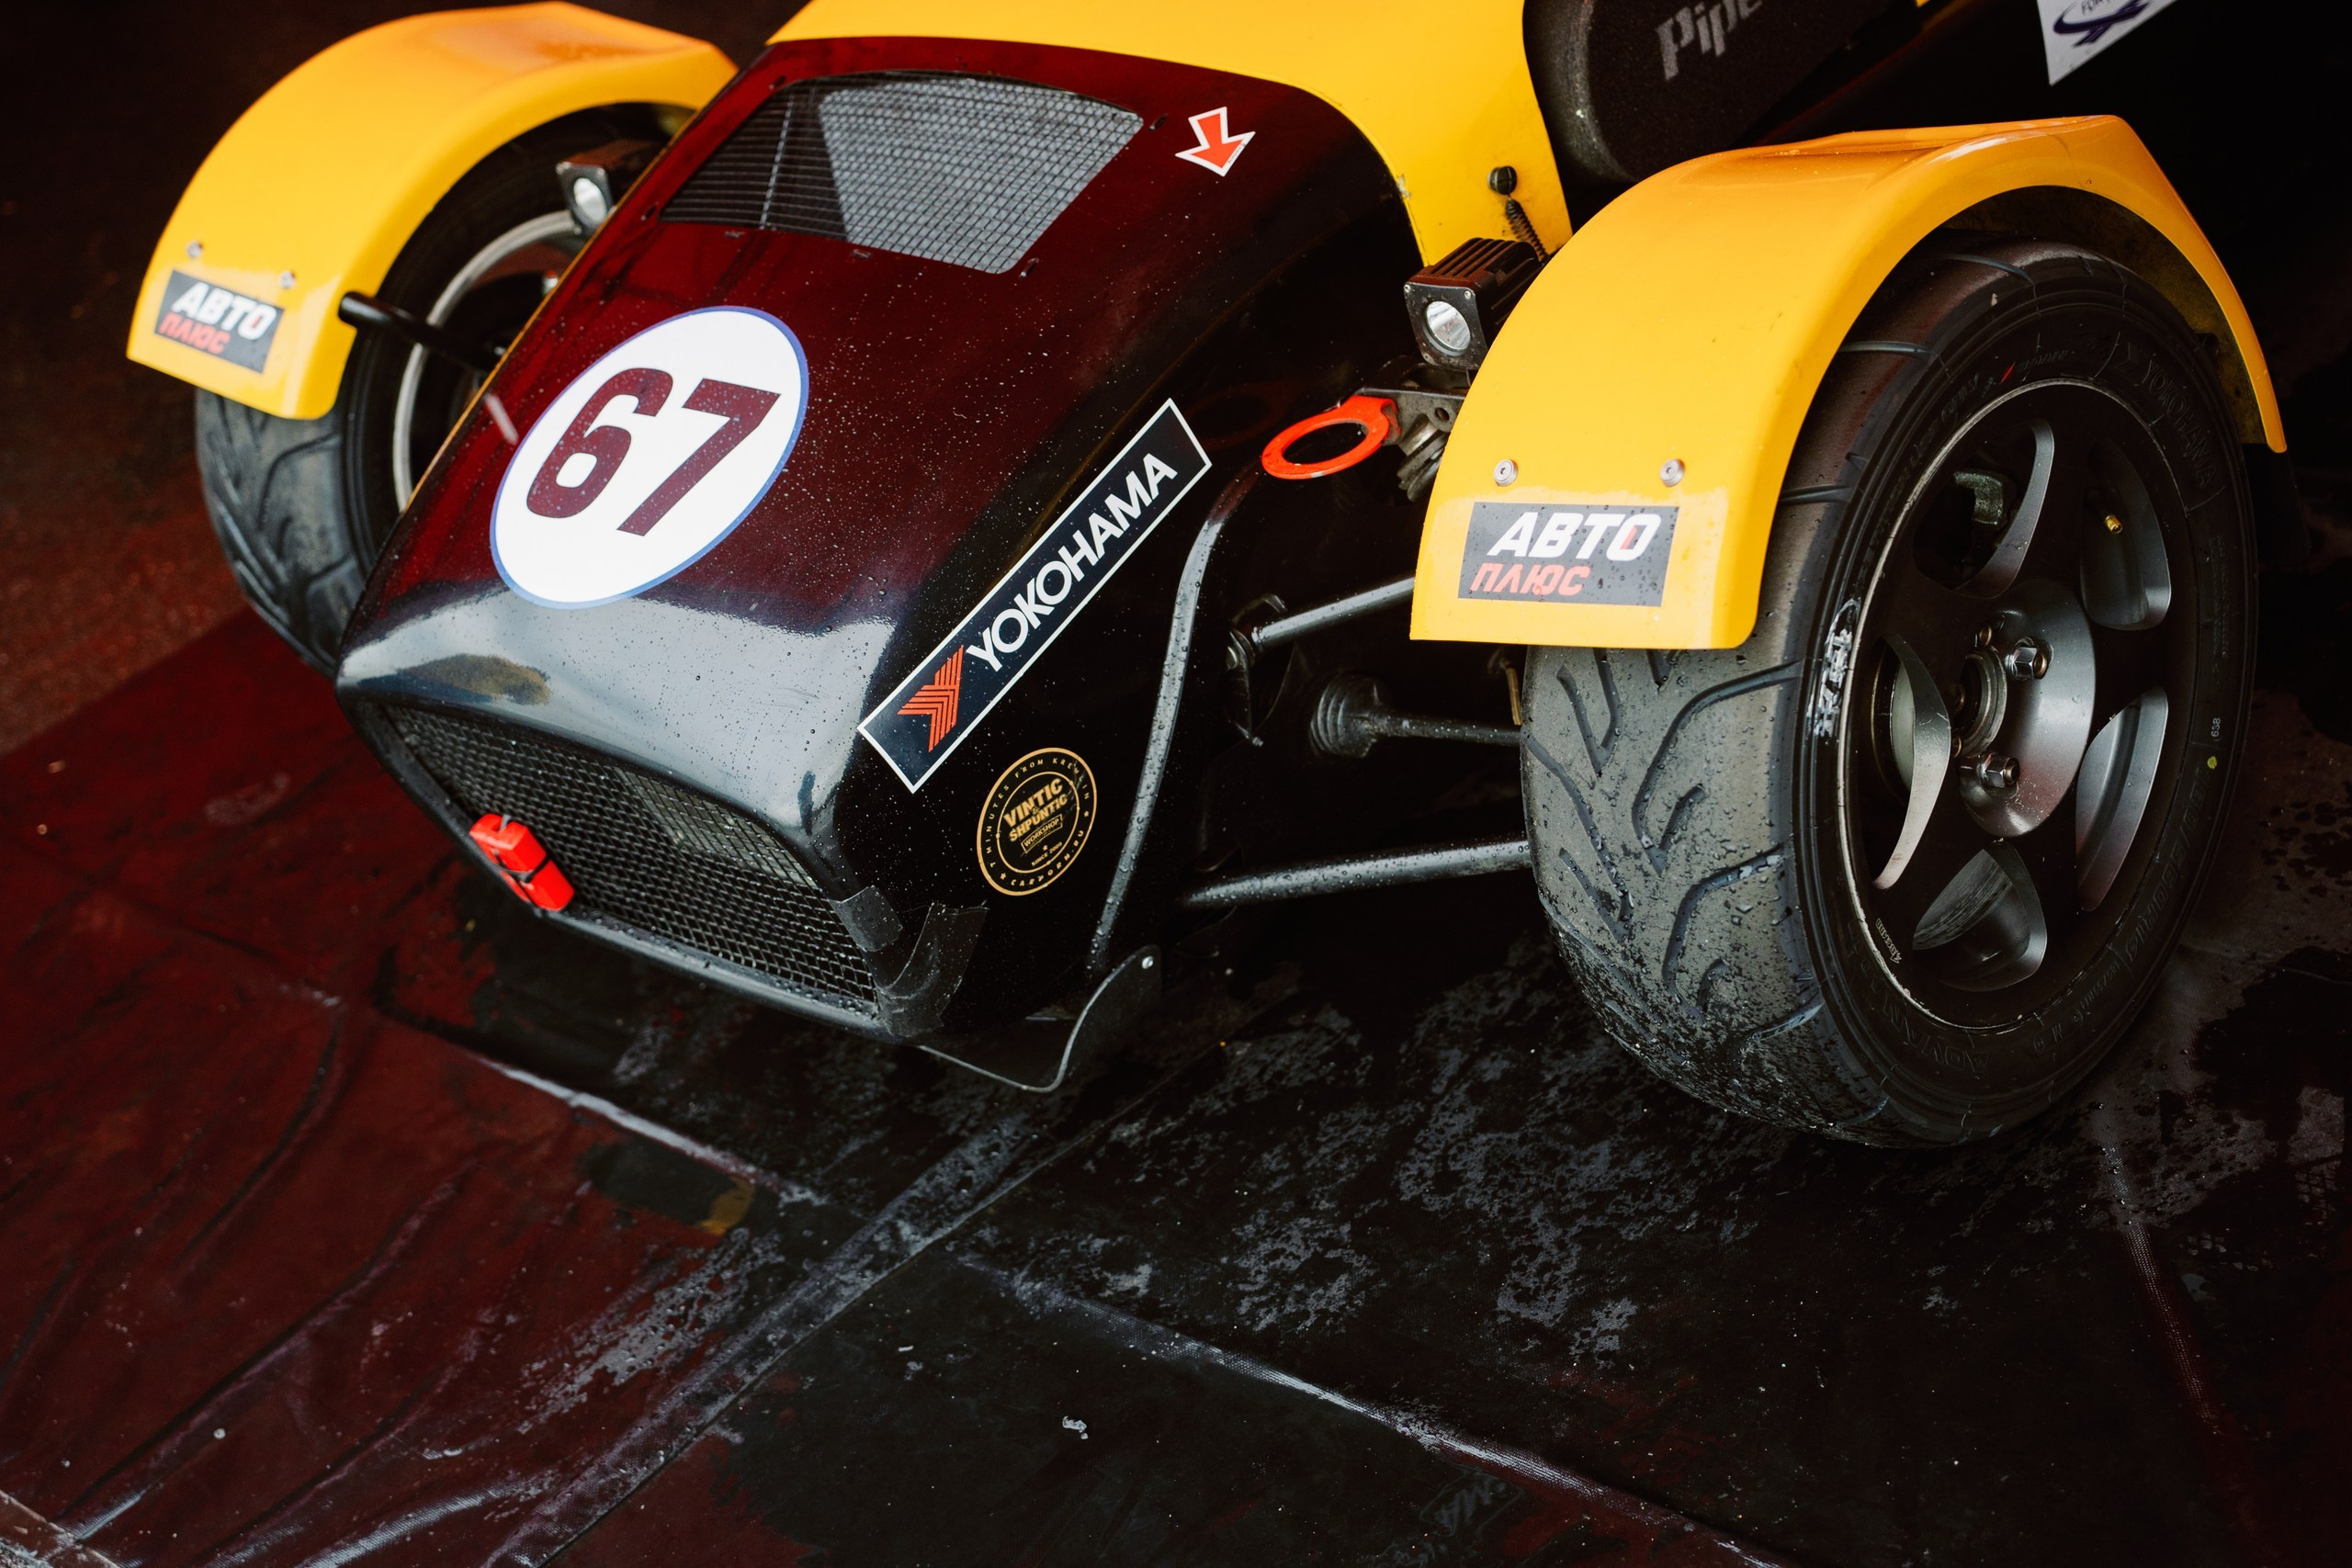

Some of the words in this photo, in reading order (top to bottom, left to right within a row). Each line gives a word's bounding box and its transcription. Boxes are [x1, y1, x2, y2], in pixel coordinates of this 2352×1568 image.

[159, 310, 231, 355] ПЛЮС
[171, 281, 277, 340] АВТО
[2141, 355, 2222, 491] YOKOHAMA
[526, 367, 782, 537] 67
[966, 452, 1178, 672] YOKOHAMA
[1486, 511, 1662, 562] АВТО
[1469, 562, 1591, 596] ПЛЮС
[985, 784, 1010, 854] MINUTES
[1014, 759, 1045, 778] FROM
[1003, 778, 1064, 827] VINTIC
[1009, 794, 1069, 842] SHPUNTIC
[1023, 818, 1059, 848] WORKSHOP
